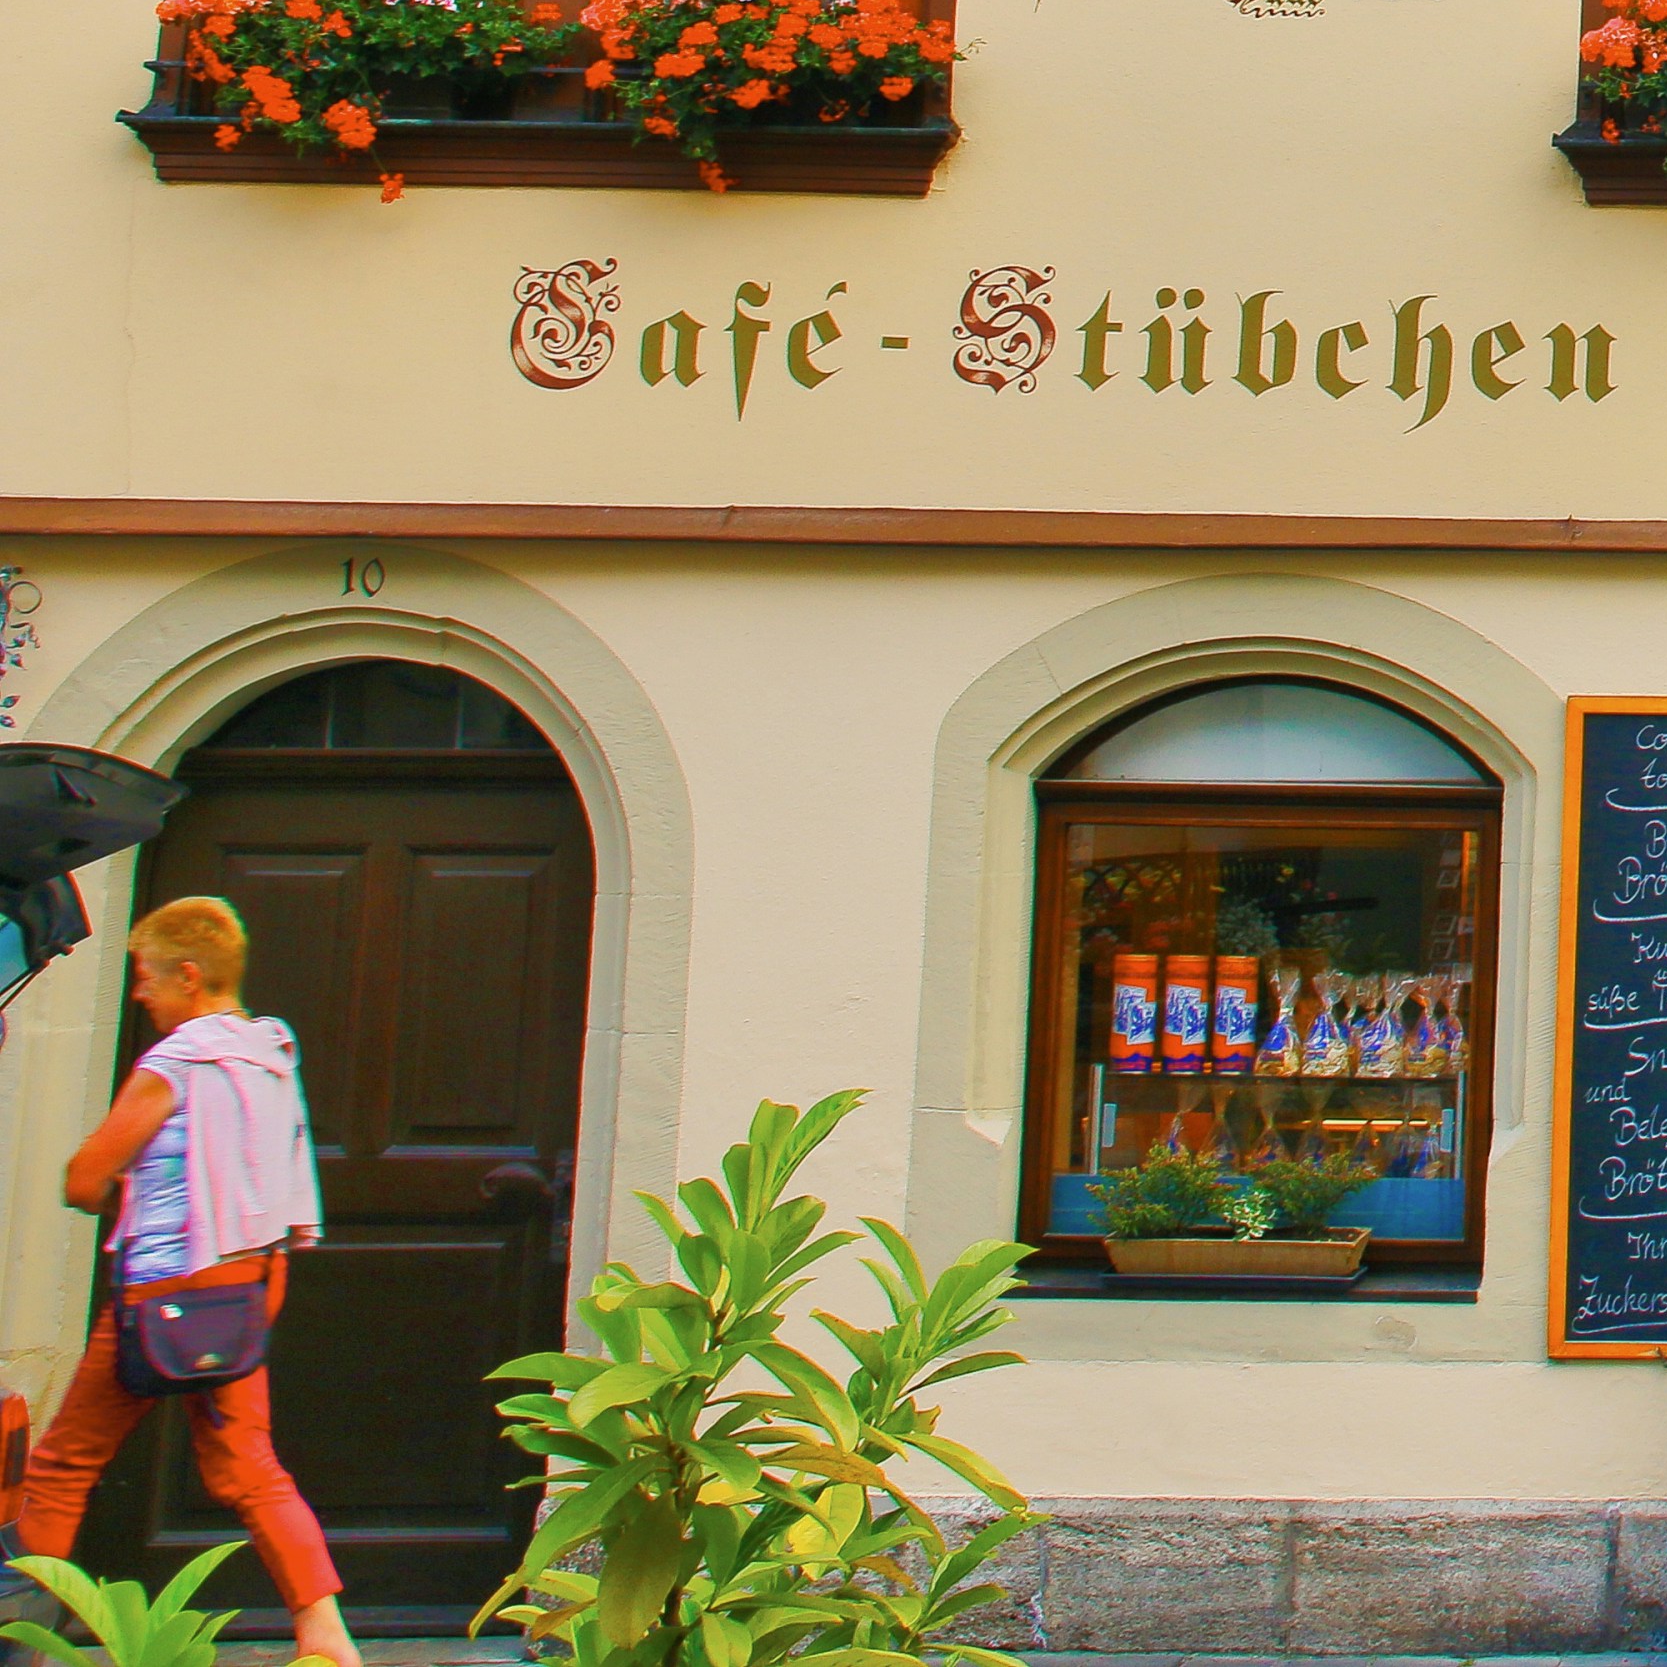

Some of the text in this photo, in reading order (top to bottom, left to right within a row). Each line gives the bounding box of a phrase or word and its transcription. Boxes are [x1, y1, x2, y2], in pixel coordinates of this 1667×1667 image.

[340, 557, 386, 599] 10
[1588, 986, 1640, 1018] süße
[1585, 1078, 1631, 1103] und
